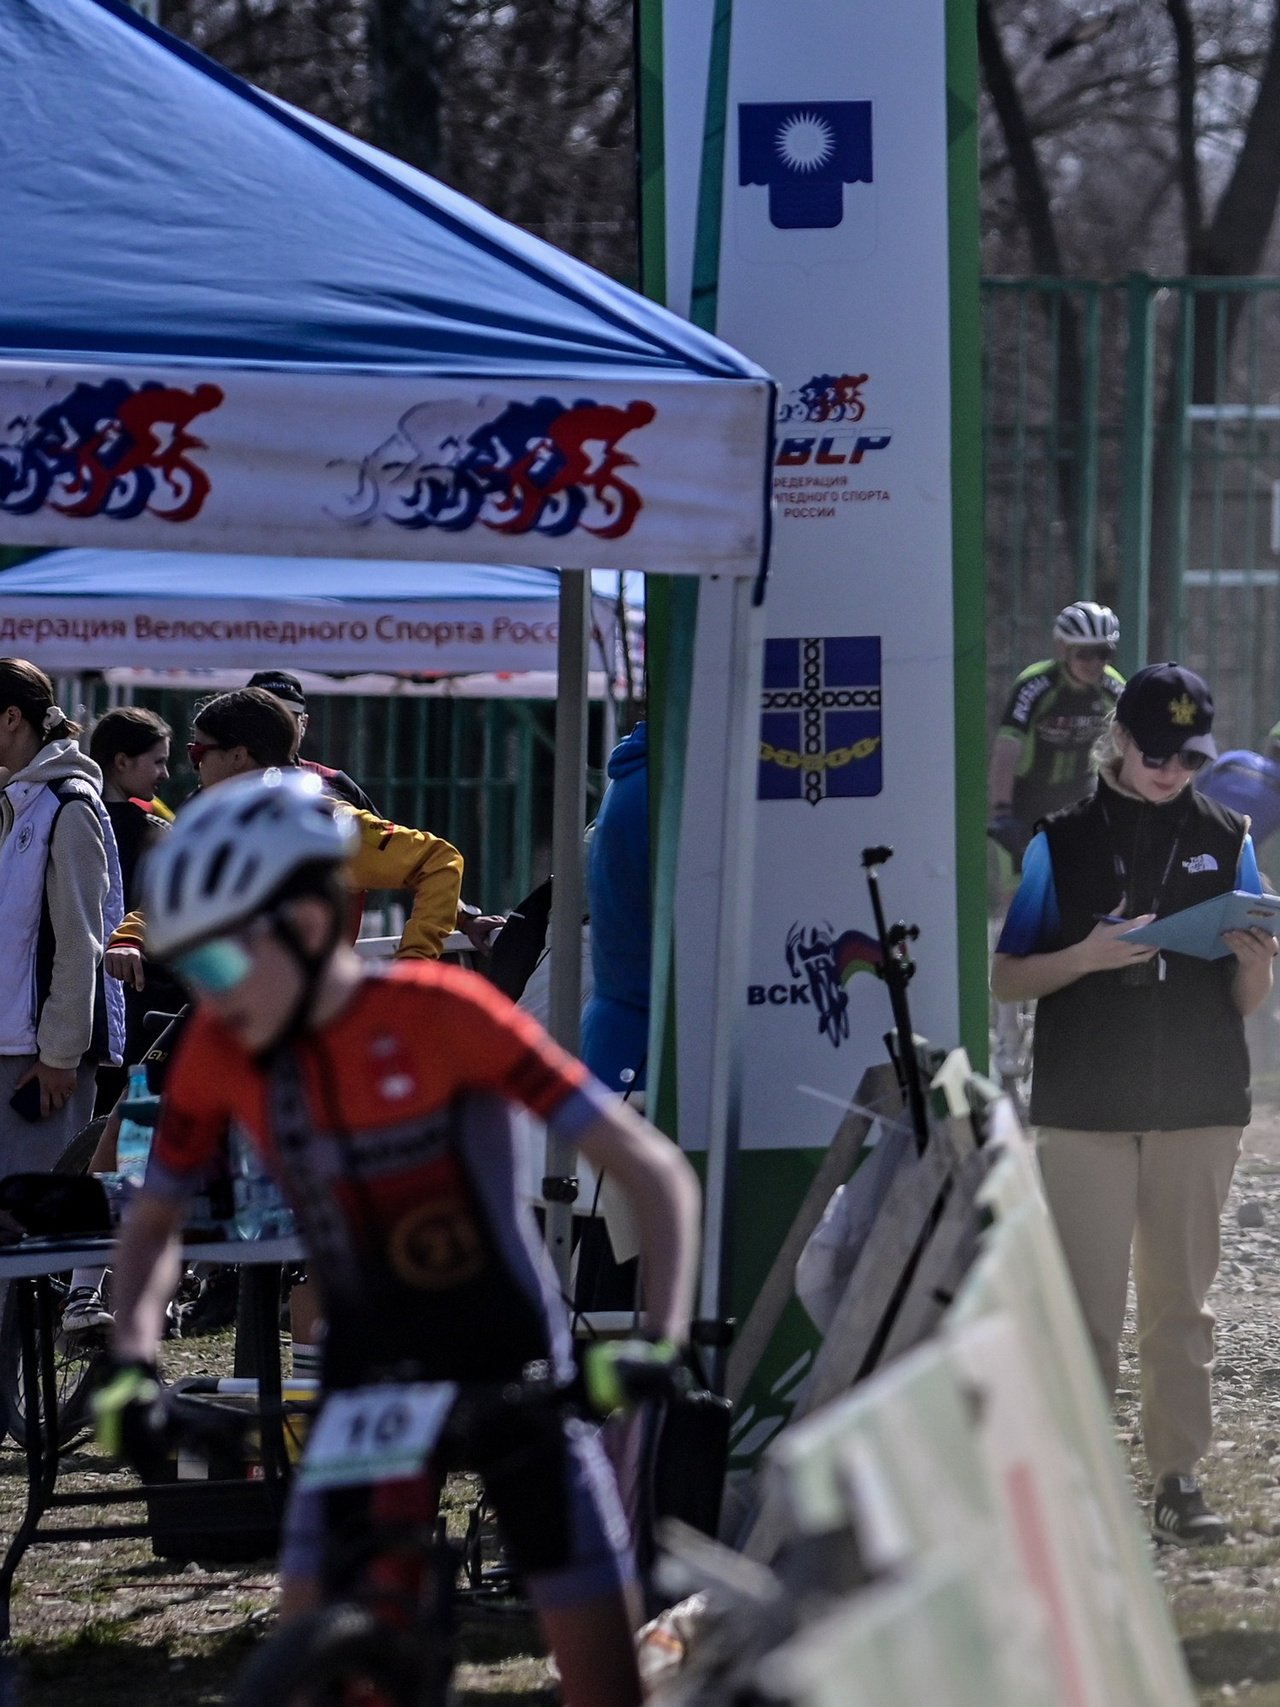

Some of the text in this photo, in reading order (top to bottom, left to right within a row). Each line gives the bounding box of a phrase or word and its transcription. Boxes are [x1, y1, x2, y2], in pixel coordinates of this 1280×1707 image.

[841, 490, 890, 502] СПОРТА
[783, 507, 836, 518] РОССИИ
[134, 614, 368, 645] Велосипедного
[375, 615, 484, 647] Спорта
[747, 984, 811, 1005] ВСК
